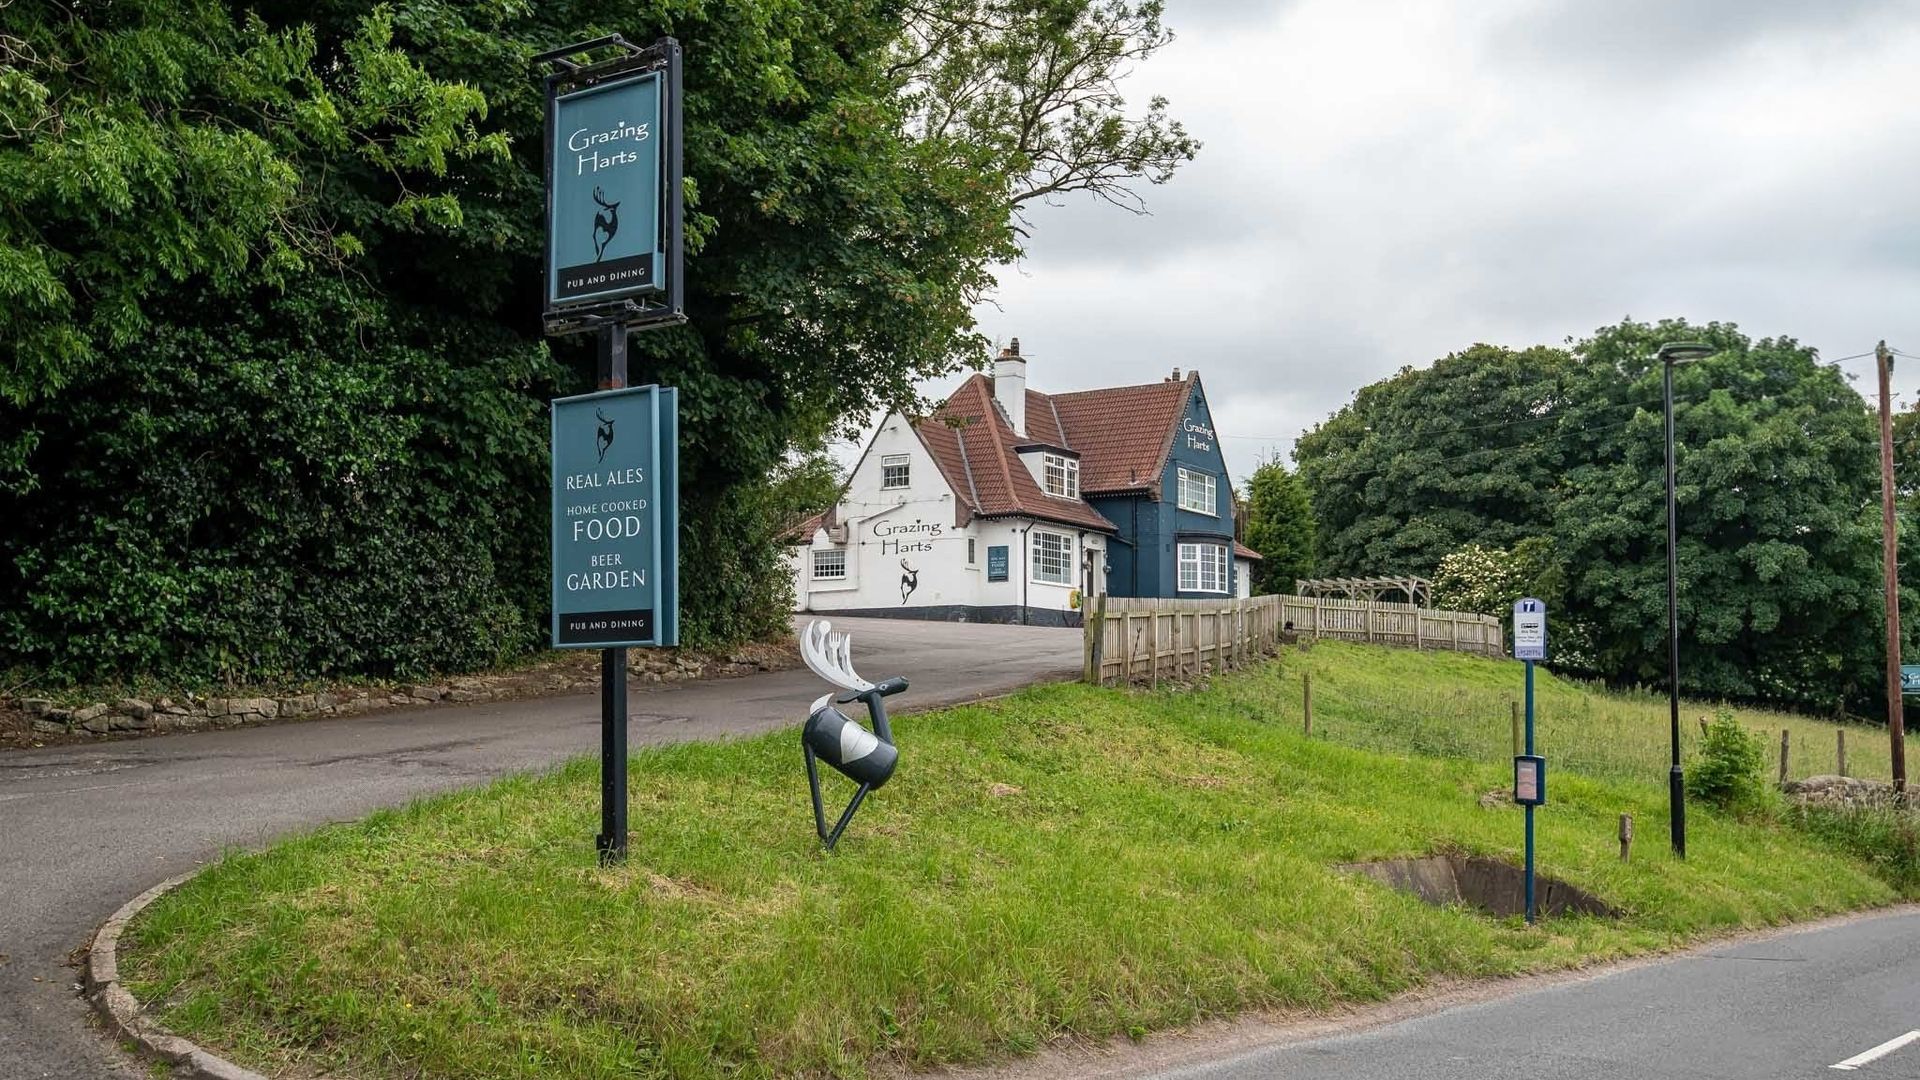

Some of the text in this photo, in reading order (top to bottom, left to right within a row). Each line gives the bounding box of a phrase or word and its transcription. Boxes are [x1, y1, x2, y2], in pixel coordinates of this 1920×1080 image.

[568, 121, 650, 152] Grazing
[578, 151, 637, 176] Harts
[567, 267, 645, 289] PUB AND DINING
[1184, 417, 1214, 440] Grazing
[1187, 433, 1210, 452] Harts
[566, 468, 643, 490] REAL ALES
[567, 499, 647, 516] HOME COOKED
[574, 516, 640, 541] FOOD
[873, 519, 942, 537] Grazing
[882, 538, 932, 555] Harts
[591, 553, 622, 567] BEER
[567, 569, 645, 591] GARDEN
[570, 619, 645, 630] PUB AND DINING
